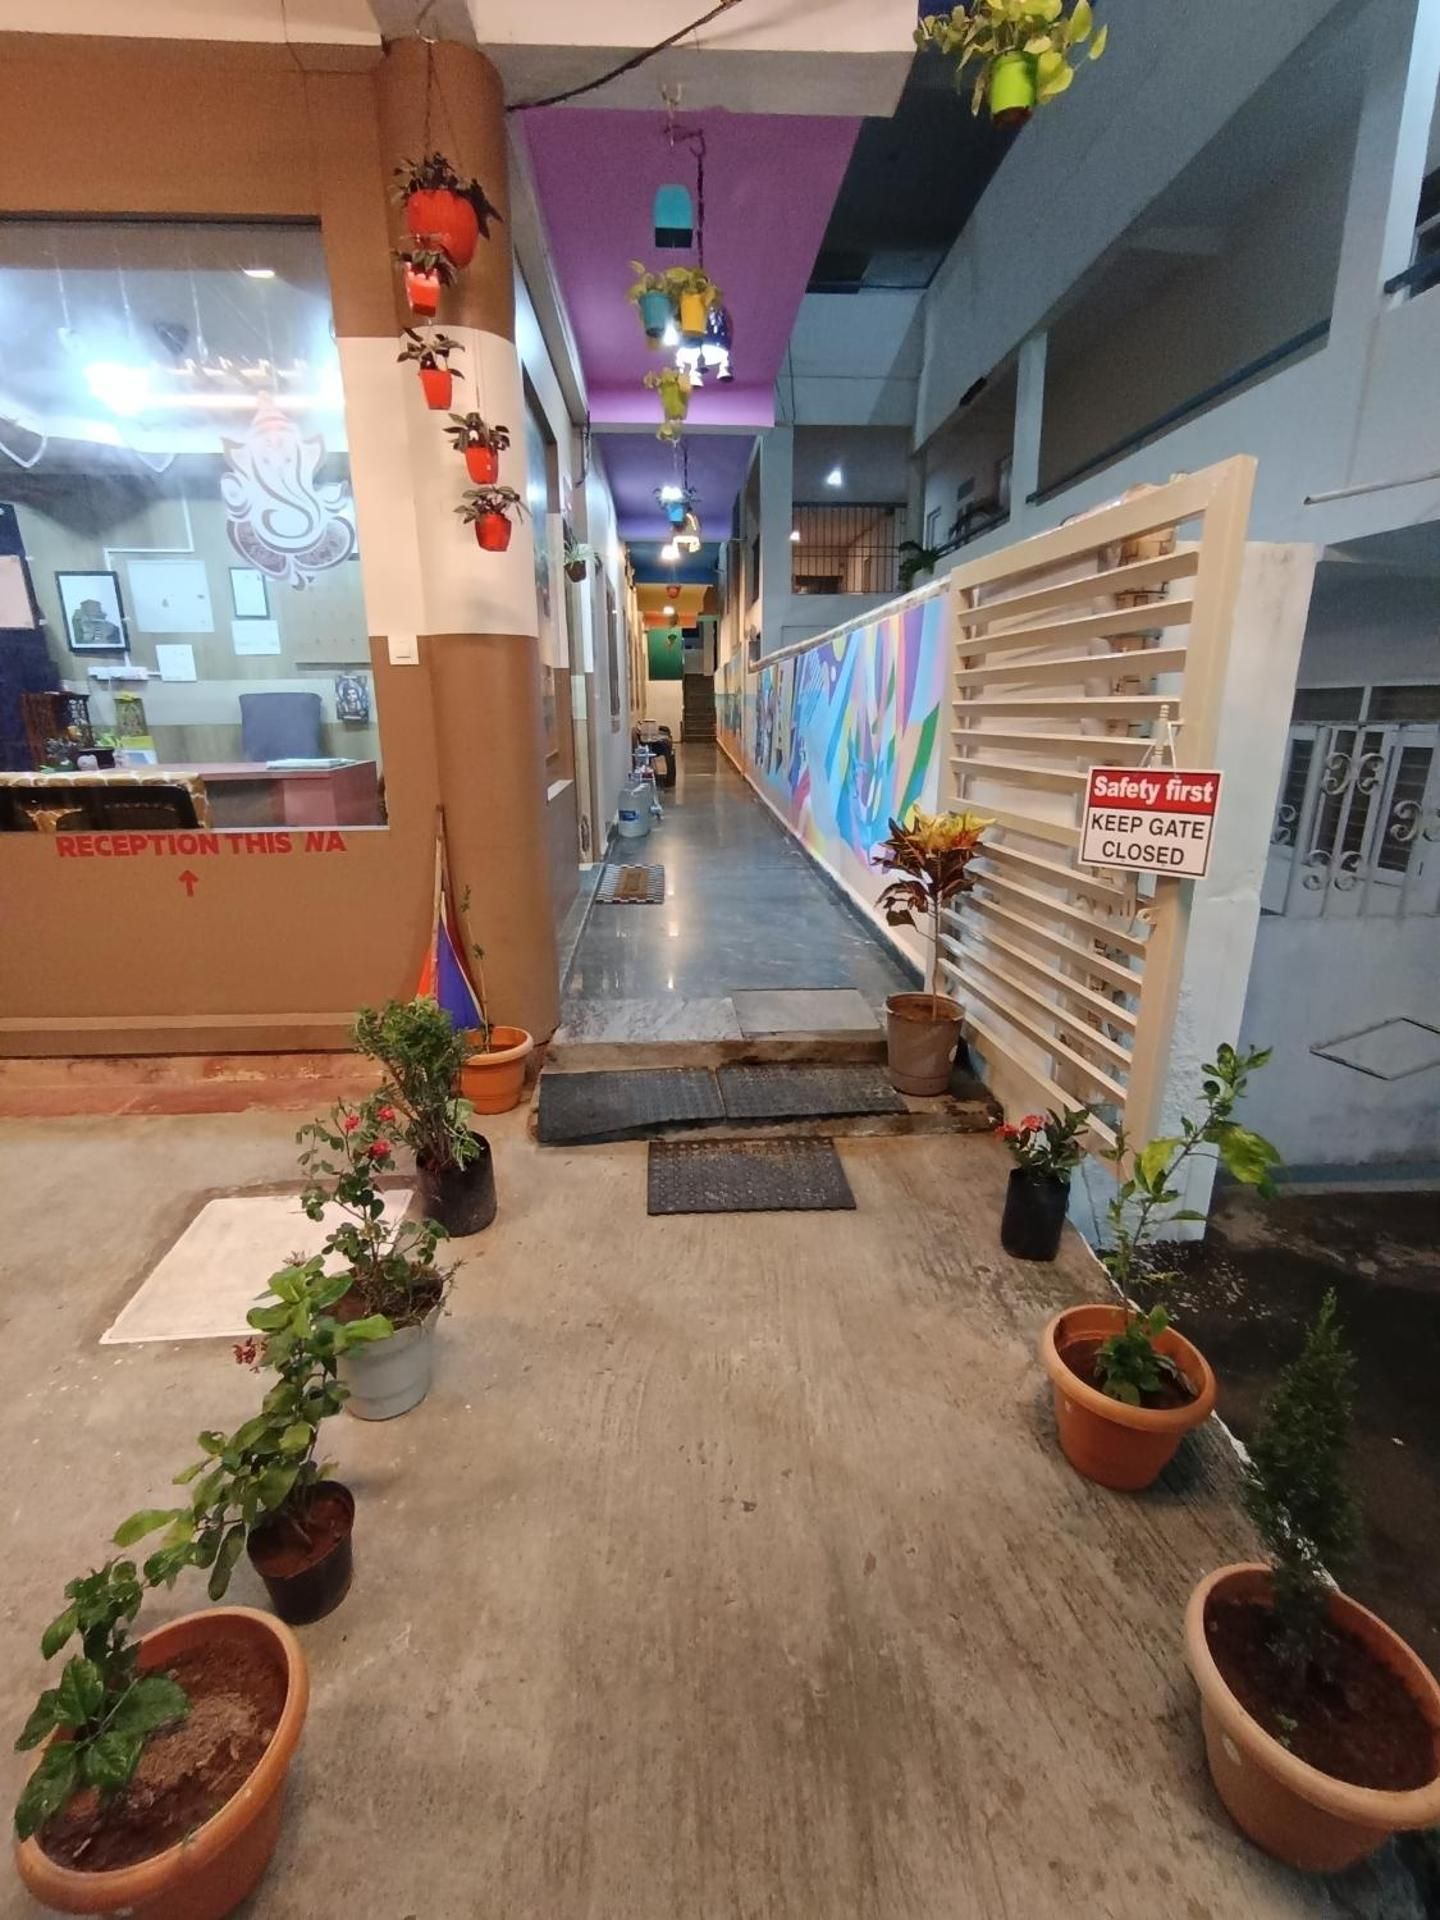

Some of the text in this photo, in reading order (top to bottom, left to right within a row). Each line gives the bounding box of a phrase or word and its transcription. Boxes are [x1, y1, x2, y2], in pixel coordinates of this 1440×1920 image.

[1094, 776, 1214, 804] Safety first
[1091, 813, 1205, 840] KEEP GATE
[56, 833, 219, 857] RECEPTION
[222, 832, 292, 854] THIS
[1102, 841, 1184, 865] CLOSED
